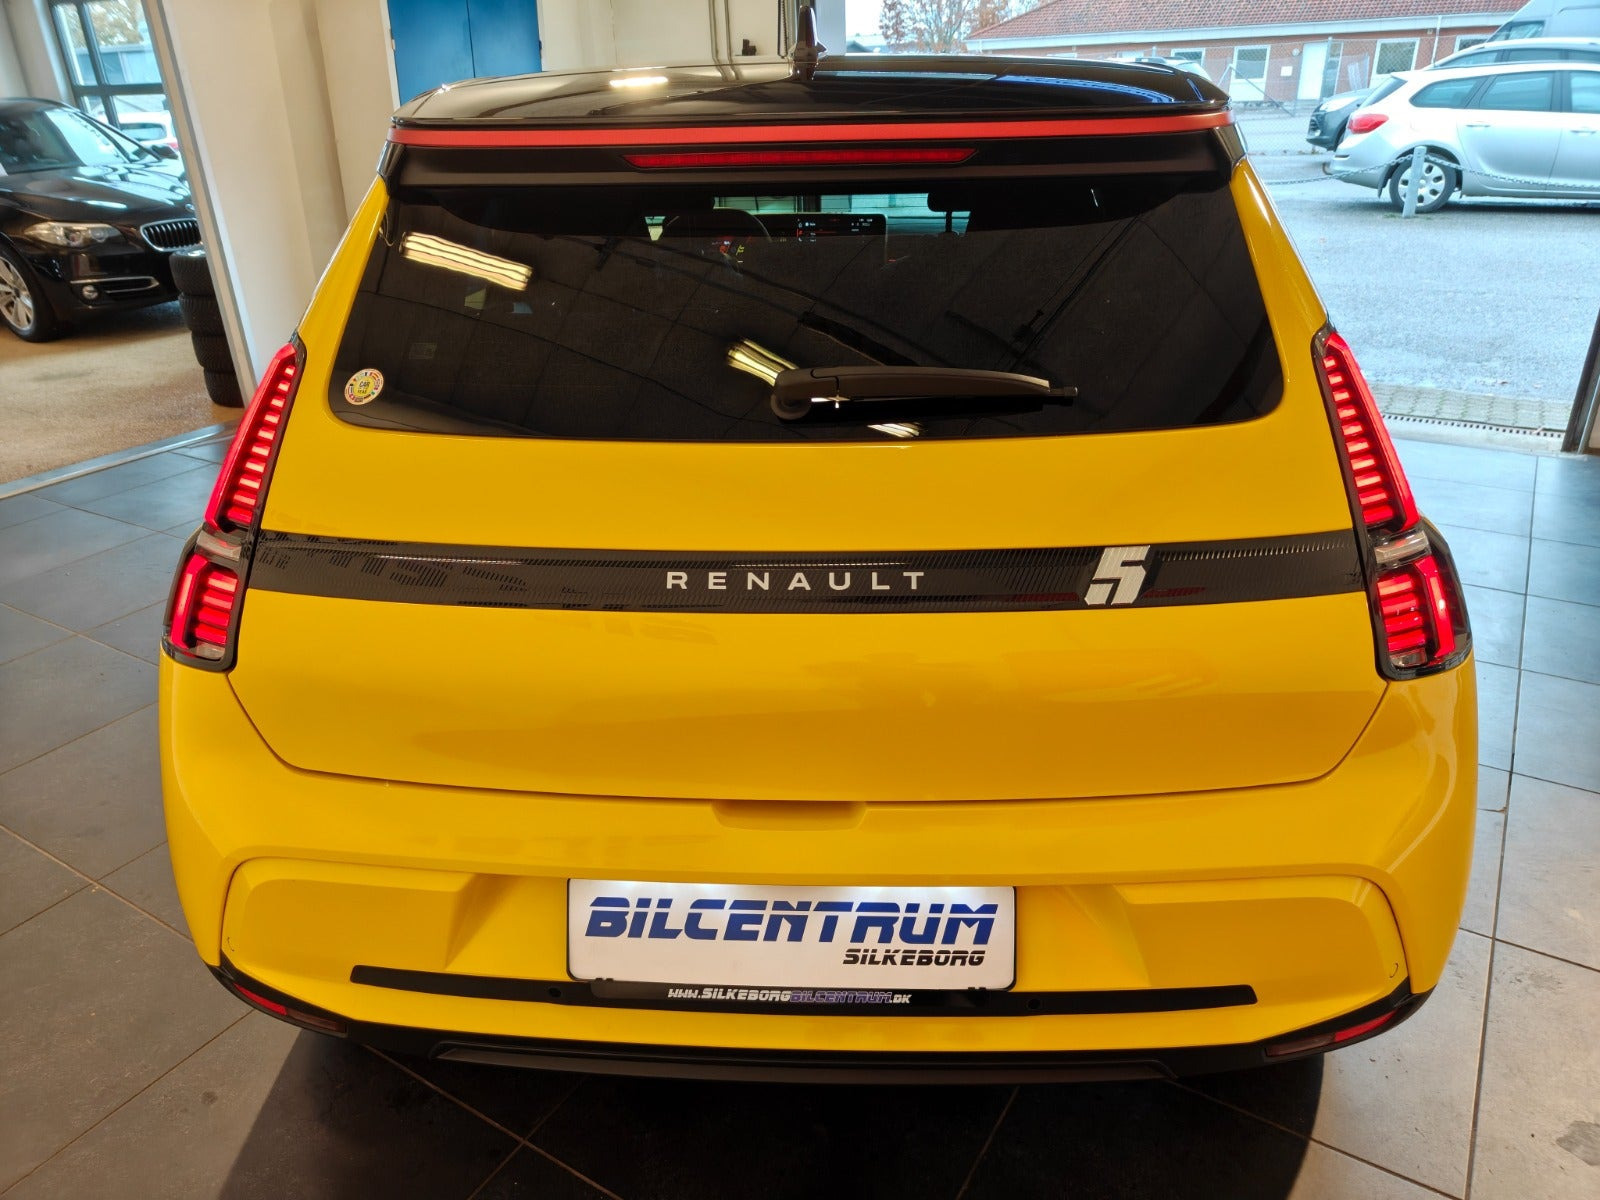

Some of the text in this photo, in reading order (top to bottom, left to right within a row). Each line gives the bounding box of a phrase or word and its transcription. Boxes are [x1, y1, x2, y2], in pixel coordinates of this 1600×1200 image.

[665, 545, 1151, 605] RENAULT 5
[584, 896, 999, 945] BILCENTRUM
[842, 948, 986, 967] SILKEBORG
